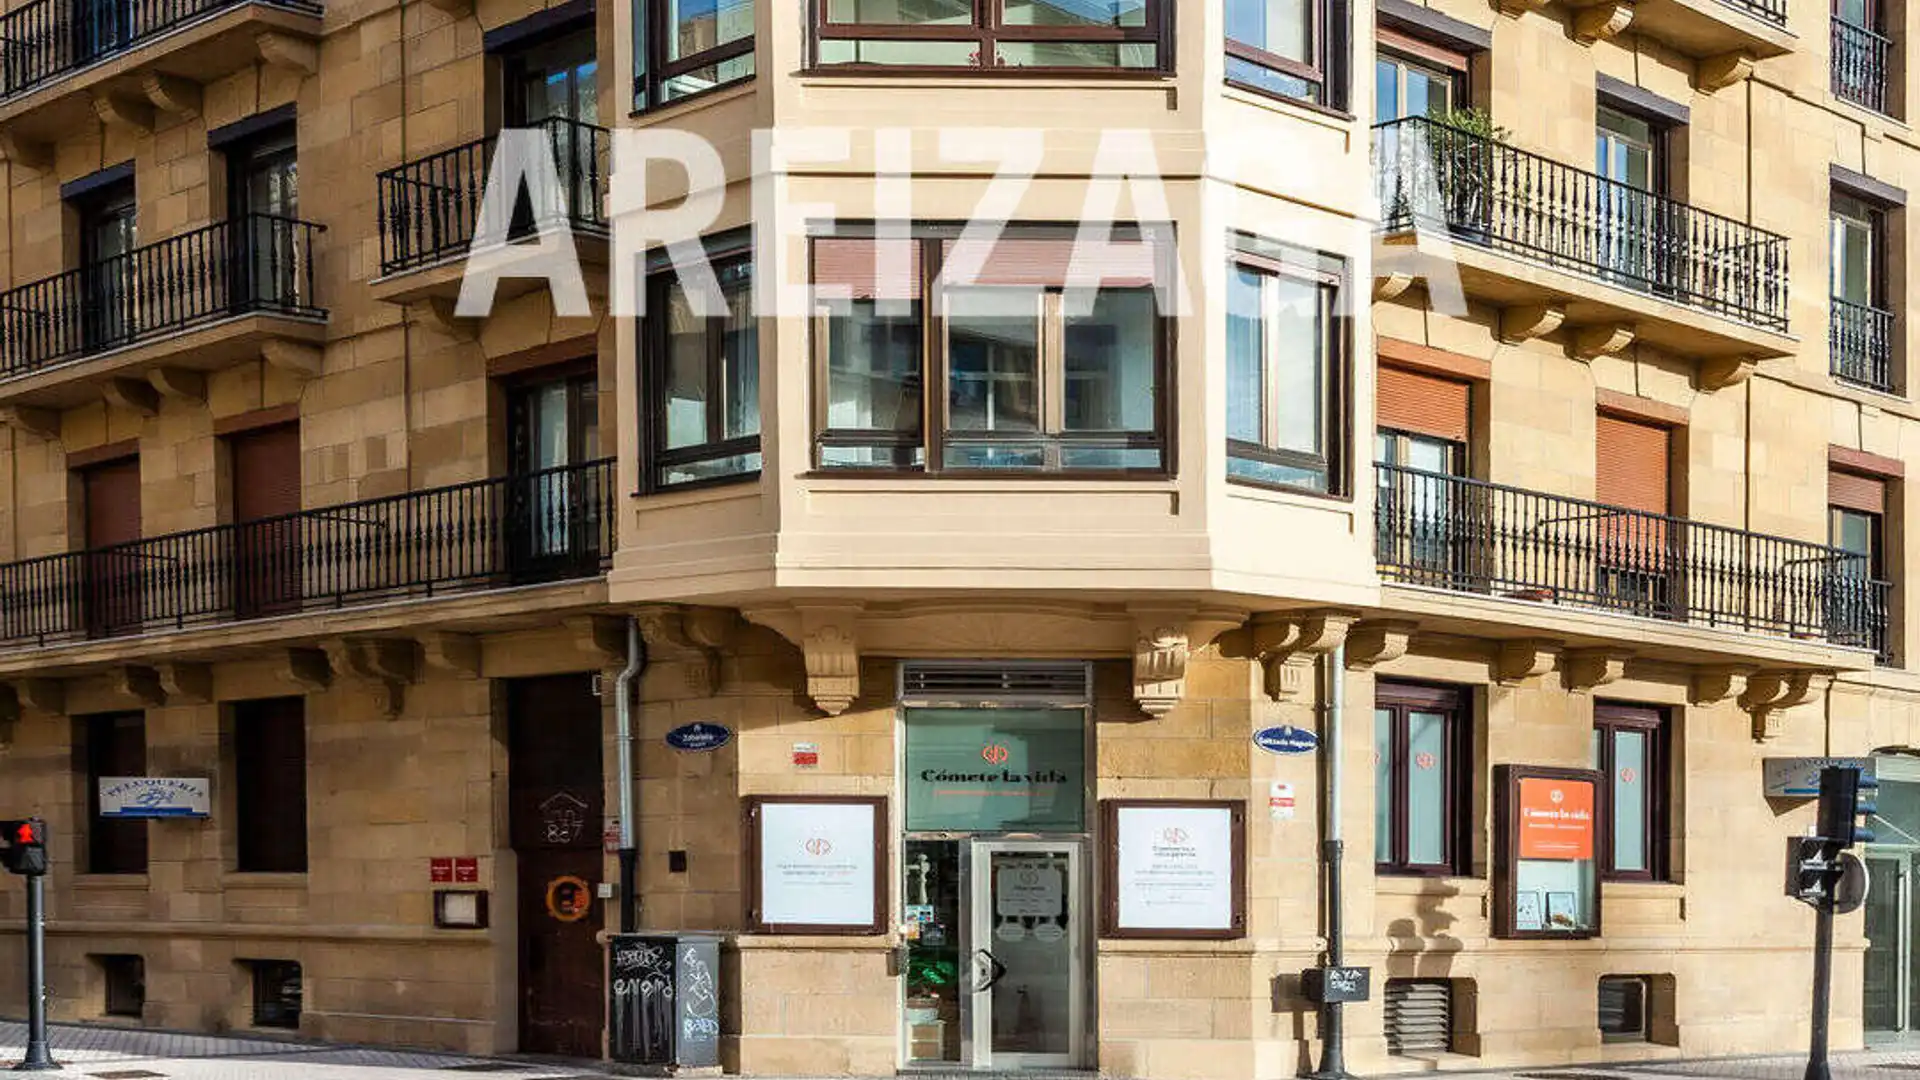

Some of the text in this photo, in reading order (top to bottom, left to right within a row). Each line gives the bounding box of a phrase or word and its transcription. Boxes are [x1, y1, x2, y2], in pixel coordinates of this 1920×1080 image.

[920, 769, 1068, 784] Cómete la vida
